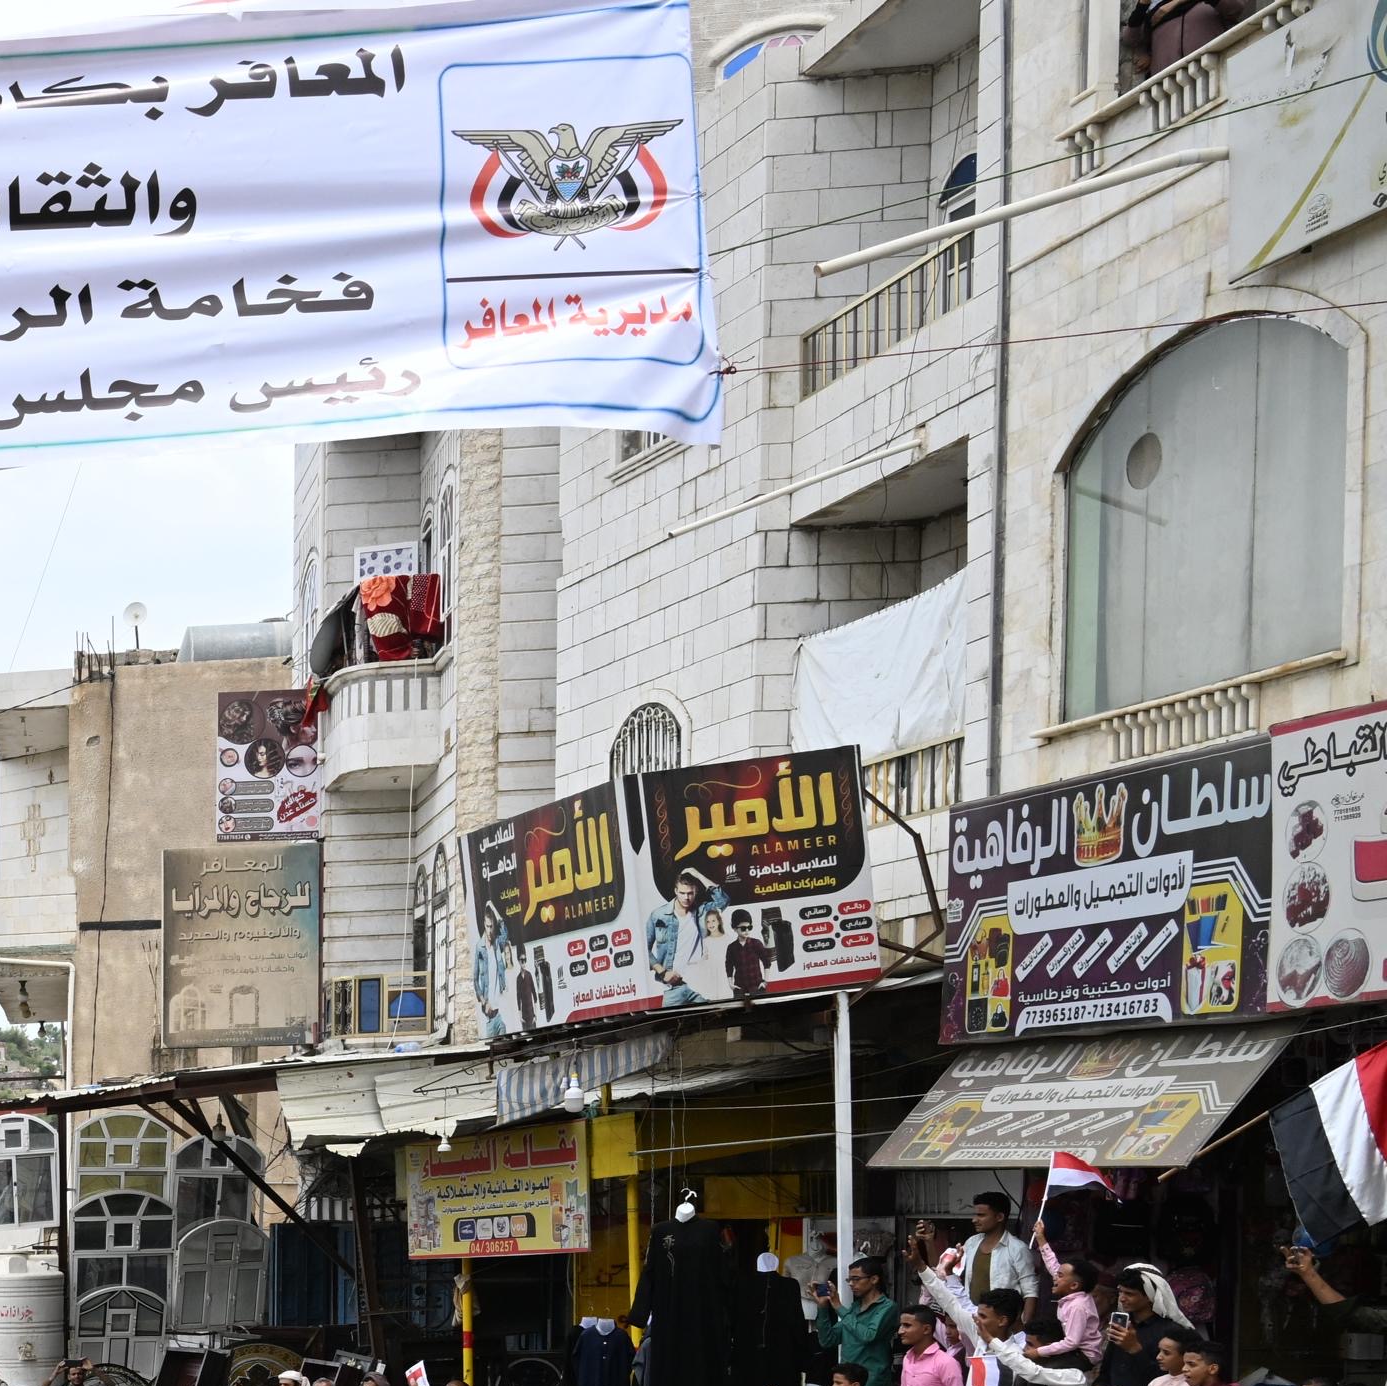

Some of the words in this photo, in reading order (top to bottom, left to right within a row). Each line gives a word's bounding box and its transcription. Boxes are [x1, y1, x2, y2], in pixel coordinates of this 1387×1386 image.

[189, 48, 406, 117] المعافر
[116, 271, 375, 321] فخامة
[454, 297, 558, 350] المعافر
[568, 294, 693, 337] مديرية
[229, 356, 423, 413] رئيس
[674, 761, 838, 862] الأمير
[1131, 760, 1272, 858] سلطان
[478, 822, 515, 853] للملابس
[750, 834, 837, 857] ALAMEER
[951, 796, 1068, 890] الرفاهية
[199, 854, 284, 878] المعافر
[481, 852, 517, 882] الجاهزة
[523, 799, 614, 927] الأمير
[748, 860, 790, 879] الجاهزة
[791, 855, 838, 875] للملابس
[753, 880, 792, 896] العالمية
[793, 876, 837, 891] والماركات
[1146, 858, 1186, 898] لأدوات
[244, 880, 312, 917] للزجاج
[1014, 883, 1081, 919] والعطورات
[1083, 871, 1143, 910] التجميل
[564, 894, 616, 921] ALAMEER
[804, 906, 827, 919] نسائي
[843, 902, 866, 914] رجالي
[805, 923, 828, 935] أطفال
[845, 917, 868, 930] شبابي
[178, 929, 231, 944] والحديد
[807, 941, 831, 951] مواليد
[845, 934, 869, 947] بناتي
[803, 960, 828, 972] المعاوز
[830, 957, 854, 967] نقشات
[854, 951, 877, 963] وأحدث
[595, 983, 616, 1001] نقشات
[615, 977, 637, 997] وأحدث
[1082, 981, 1131, 999] مكتبية
[1134, 970, 1172, 992] أدوات
[1018, 986, 1081, 1005] وقرطاسية
[1025, 997, 1160, 1026] 773965187-713416783
[951, 1042, 1084, 1087] الرفاهية
[1124, 1031, 1277, 1078] سلطان
[503, 1129, 579, 1173] بقالة
[487, 1179, 525, 1198] الغذائية
[524, 1176, 550, 1195] للمواد
[470, 1240, 515, 1255] 04/306257
